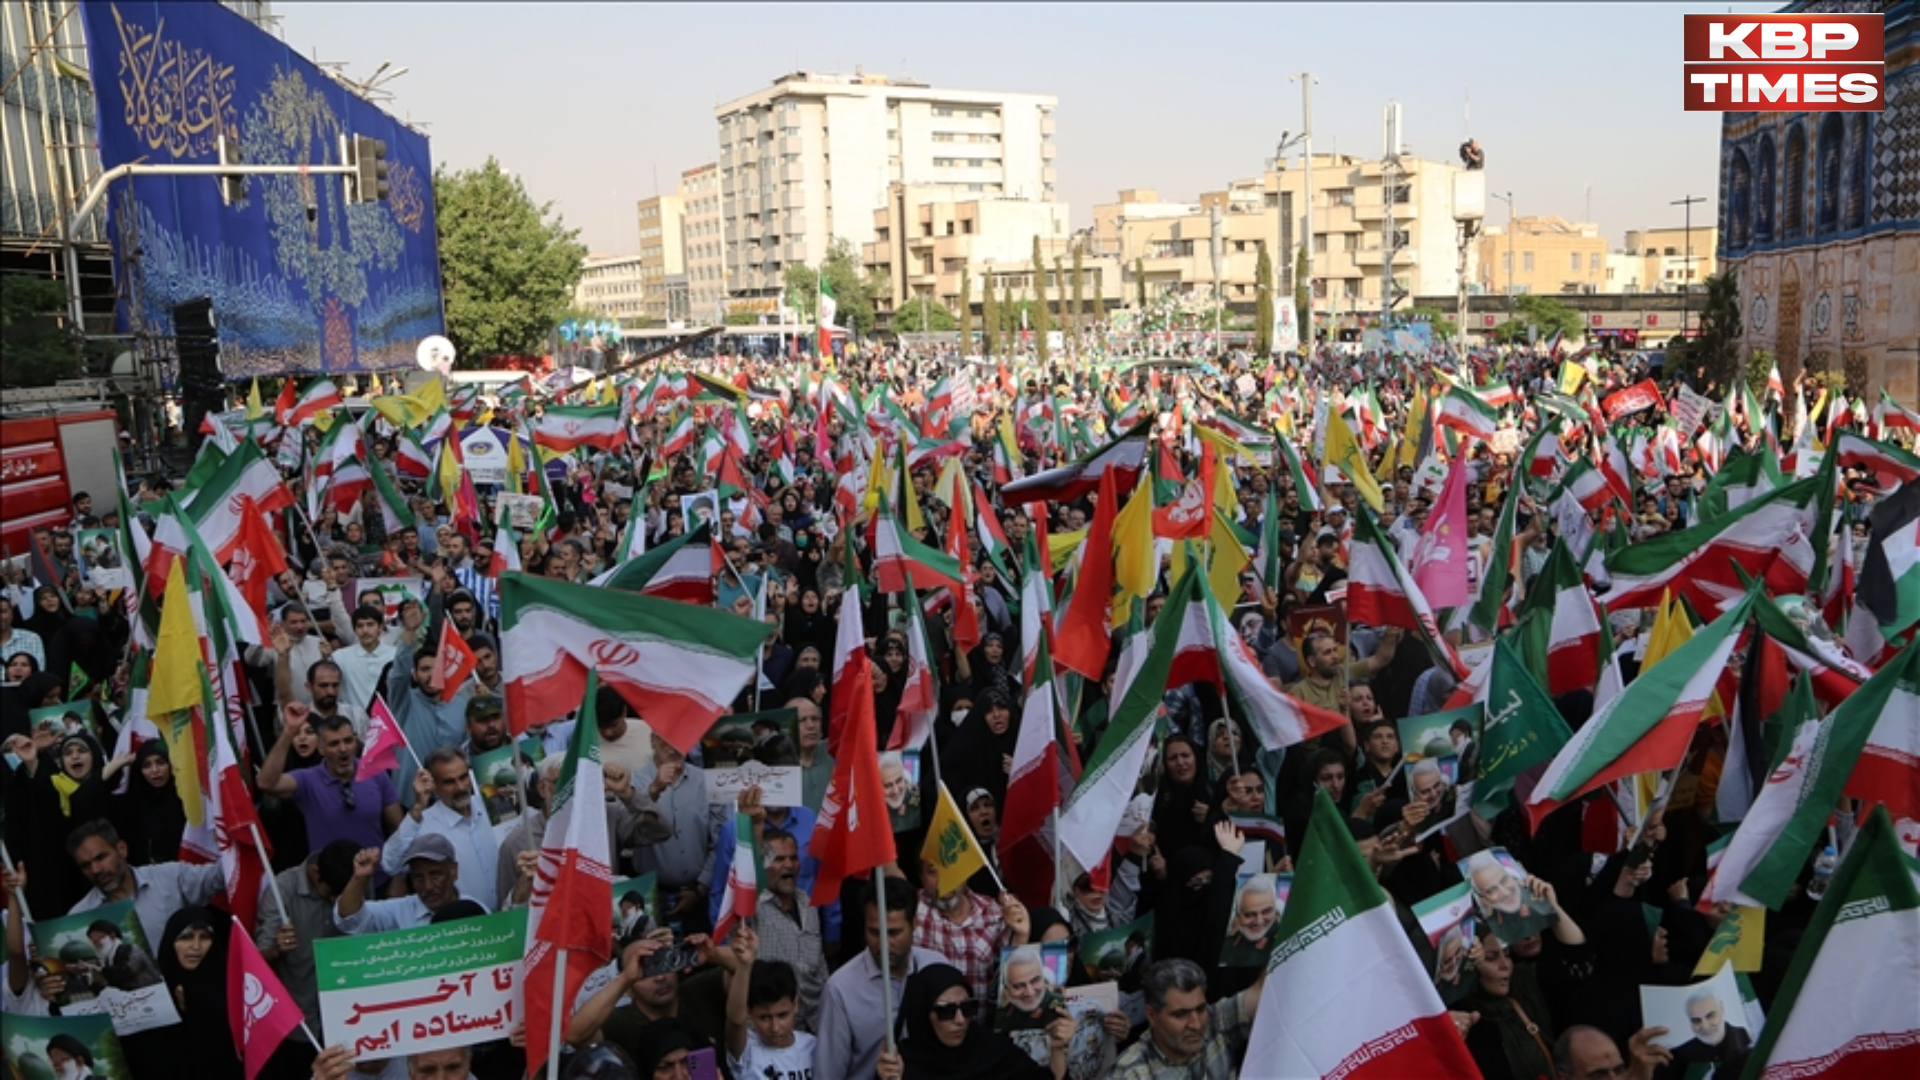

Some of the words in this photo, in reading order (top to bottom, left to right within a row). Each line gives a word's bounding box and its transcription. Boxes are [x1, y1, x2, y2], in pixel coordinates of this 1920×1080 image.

[491, 966, 514, 992] تا
[344, 972, 478, 1025] آخر
[354, 1019, 400, 1056] ایم
[412, 1000, 513, 1039] ایستاده
